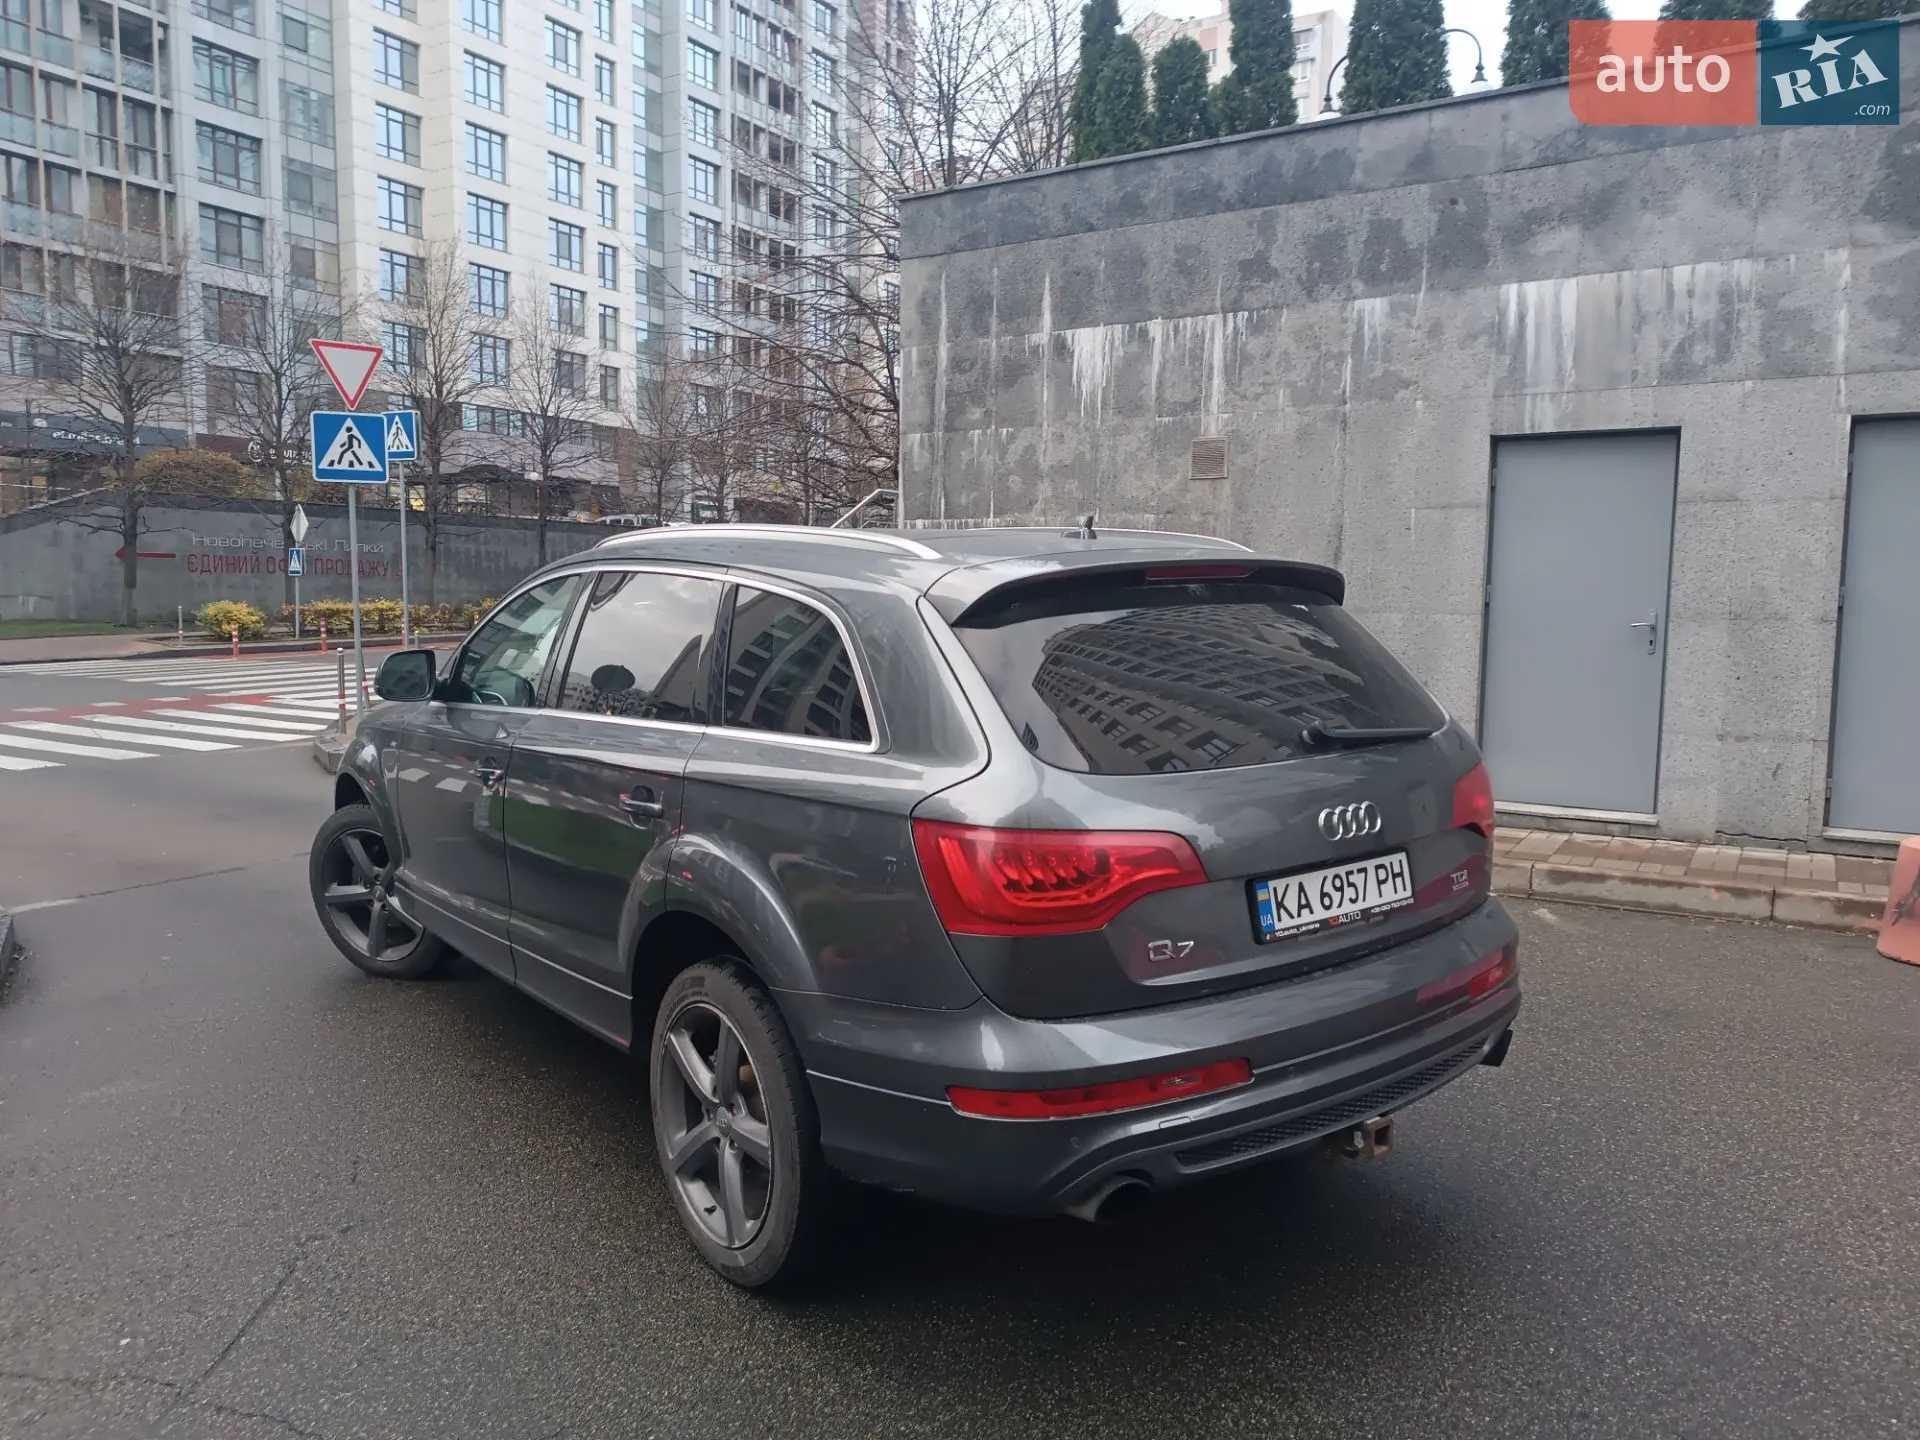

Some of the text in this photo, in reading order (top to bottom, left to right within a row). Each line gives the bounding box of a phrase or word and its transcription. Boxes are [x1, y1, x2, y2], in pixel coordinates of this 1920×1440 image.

[192, 531, 328, 552] Новопечеькі
[1272, 858, 1408, 923] KA 6957 PH
[1260, 914, 1274, 927] UA
[1147, 939, 1195, 962] Q7
